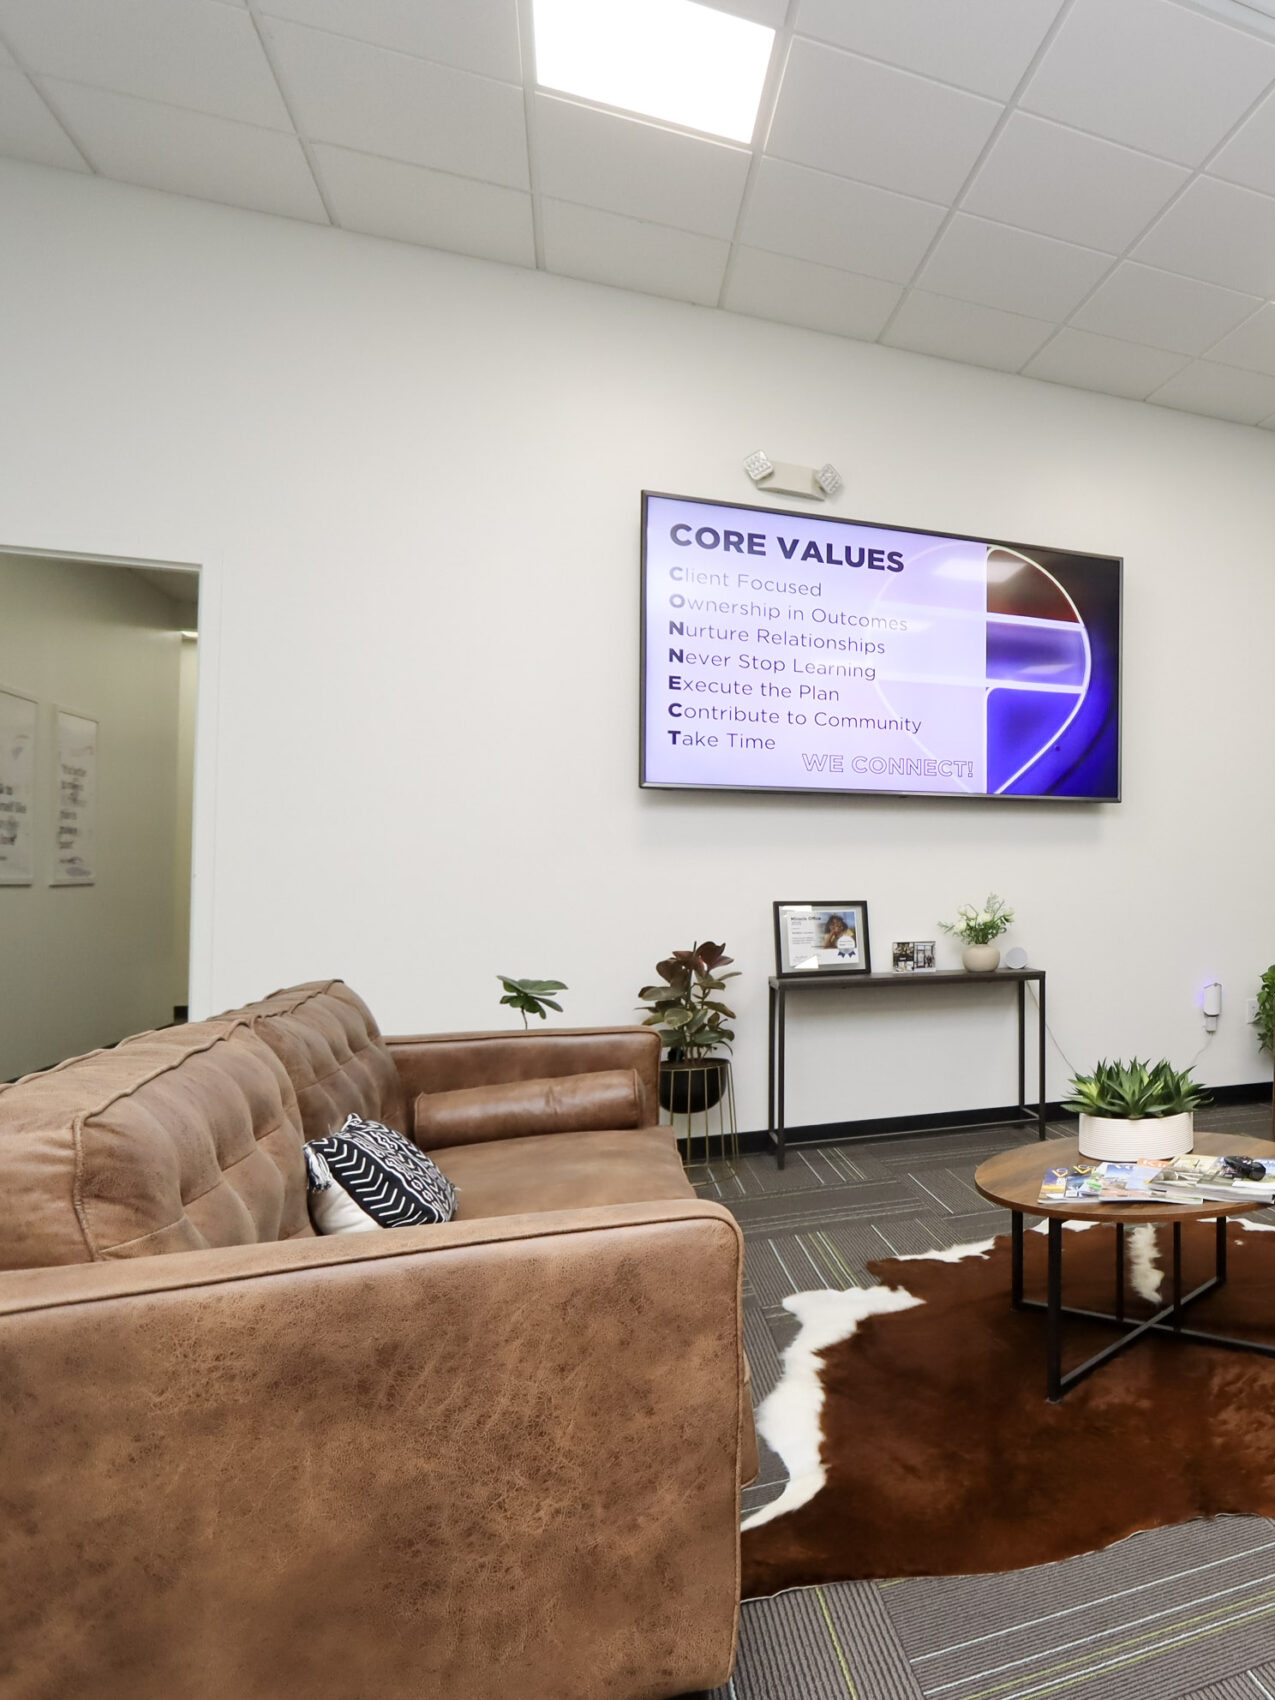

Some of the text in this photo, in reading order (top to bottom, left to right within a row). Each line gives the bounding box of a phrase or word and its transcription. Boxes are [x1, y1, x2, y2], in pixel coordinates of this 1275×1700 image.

[670, 523, 904, 572] CORE VALUES
[669, 566, 822, 597] Client Focused
[669, 594, 908, 631] Ownership in Outcomes
[669, 621, 885, 655] Nurture Relationships
[669, 648, 876, 682] Never Stop Learning
[669, 675, 839, 701] Execute the Plan
[668, 703, 922, 735] Contribute to Community
[668, 730, 776, 750] Take Time
[802, 753, 973, 778] WE CONNECT!
